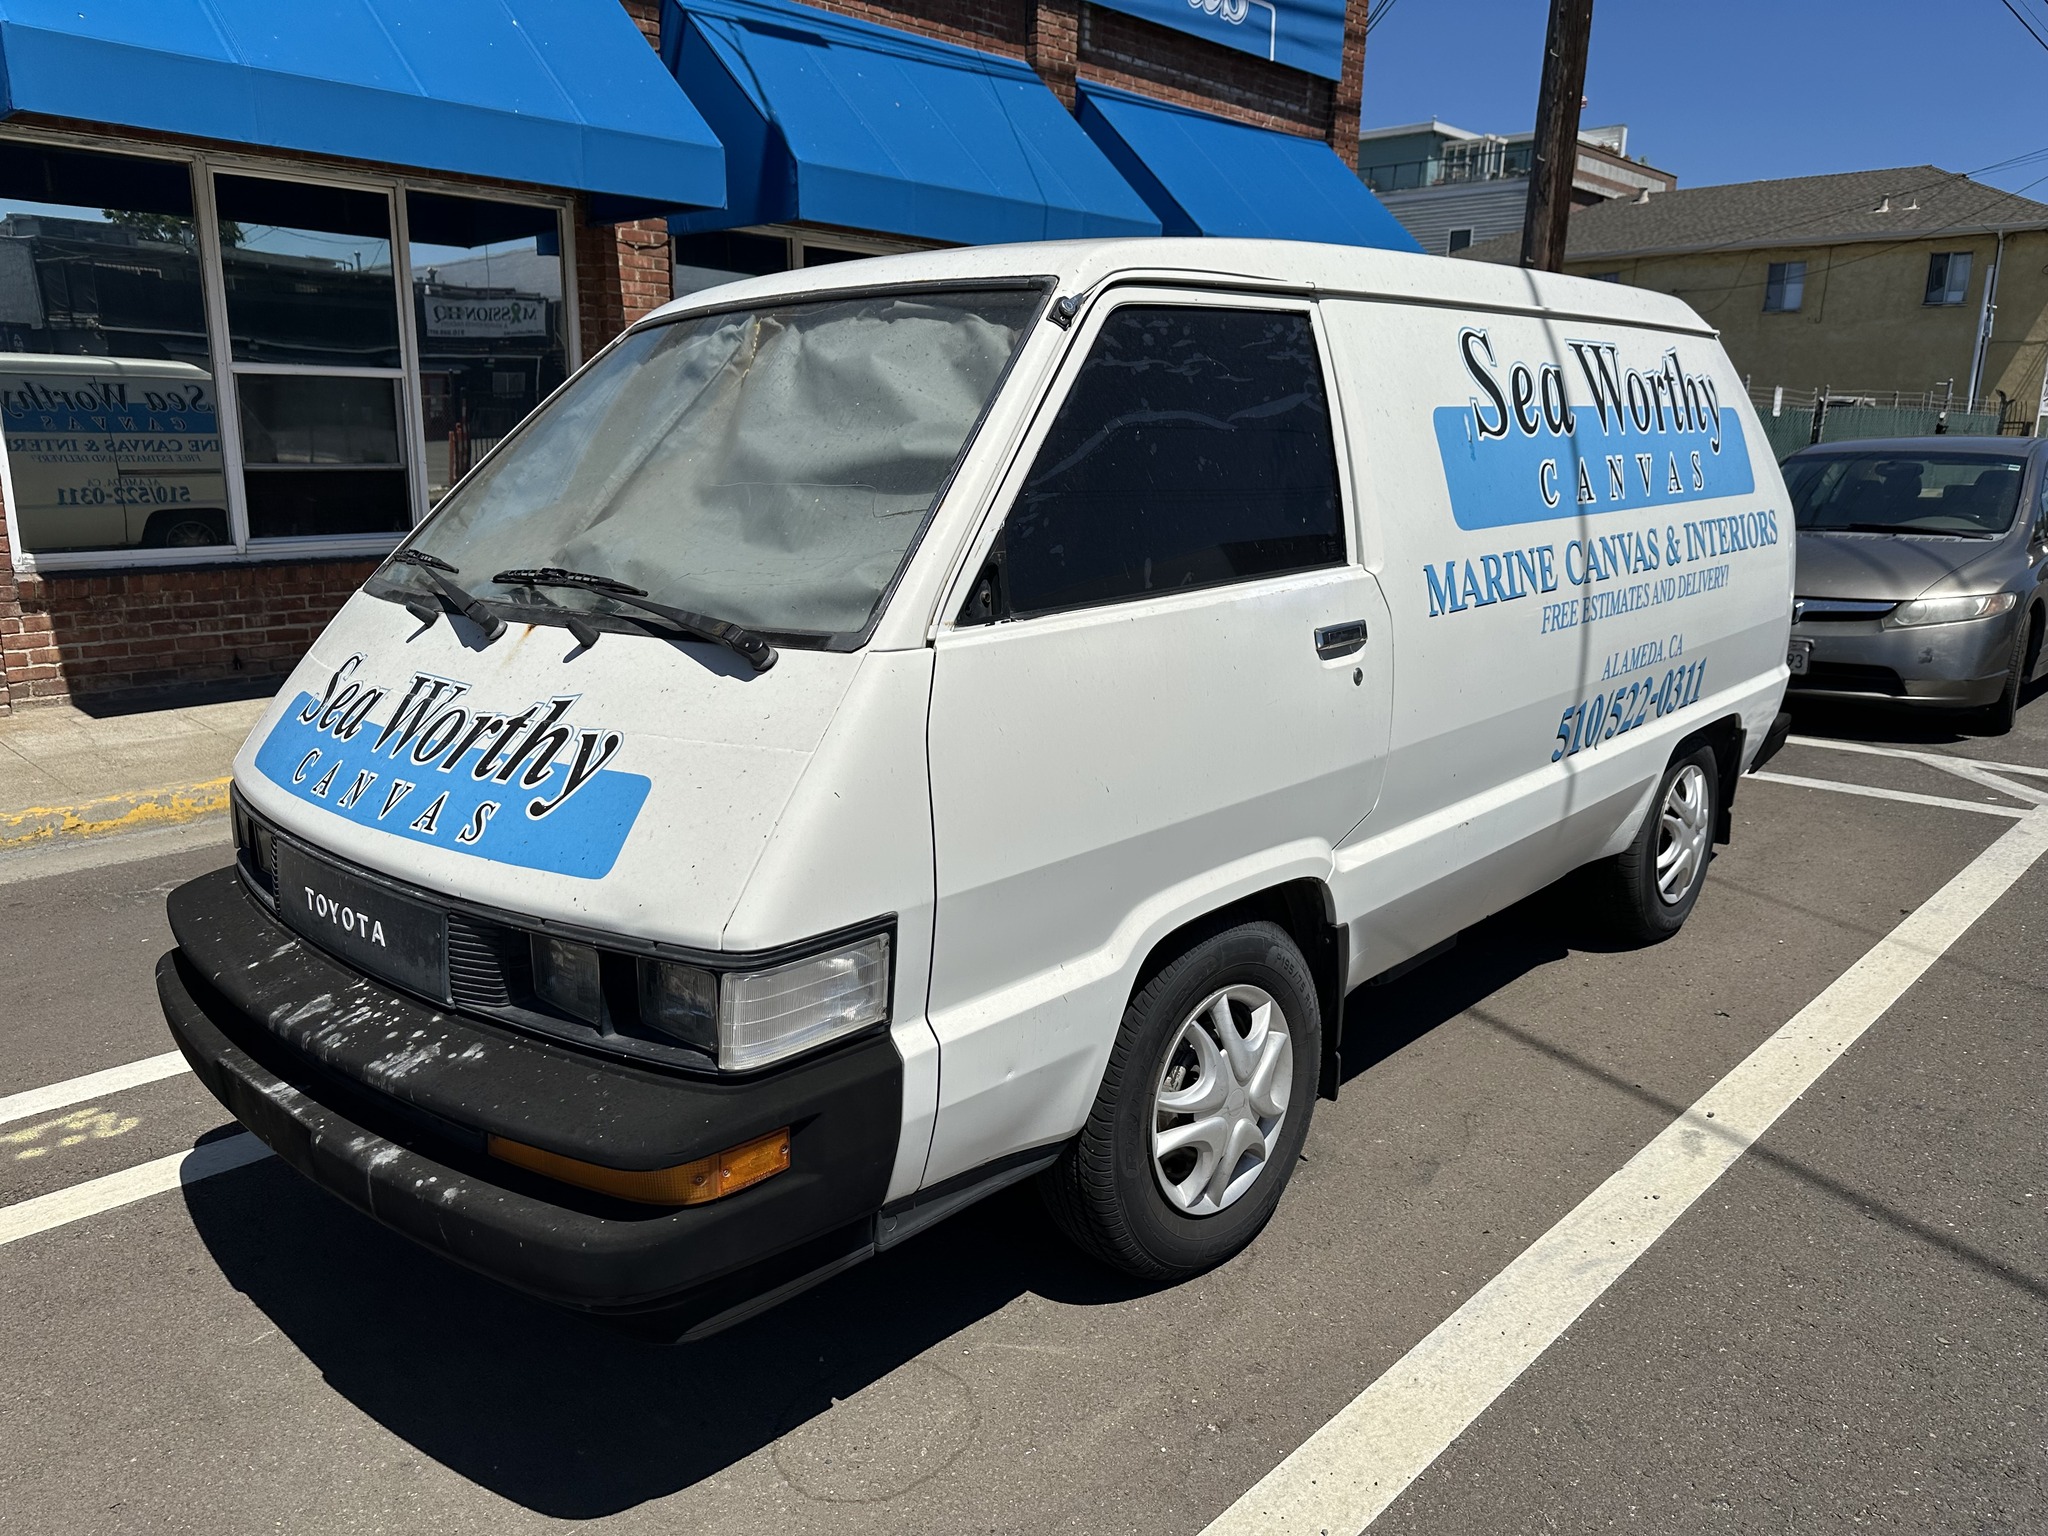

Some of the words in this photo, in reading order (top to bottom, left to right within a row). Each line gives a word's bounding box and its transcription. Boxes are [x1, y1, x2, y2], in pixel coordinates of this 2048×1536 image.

[1460, 329, 1575, 438] Sea
[1565, 339, 1722, 453] Worthy
[1540, 452, 1702, 507] CANVAS
[1424, 546, 1558, 617] MARINE
[1565, 529, 1660, 586] CANVAS
[1666, 526, 1681, 564] &
[1683, 509, 1778, 562] INTERIORS
[1541, 601, 1578, 633] FREE
[1581, 584, 1650, 624] ESTIMATES
[1651, 579, 1676, 605] AND
[1678, 565, 1729, 599] DELIVERY!
[1601, 641, 1667, 681] ALAMEDA,
[1668, 634, 1682, 657] CA
[301, 652, 390, 740] Sea
[374, 672, 624, 820] Worthy
[1551, 657, 1707, 762] 510/522-0311
[292, 749, 500, 846] CANVAS
[304, 886, 388, 948] TOYOTA
